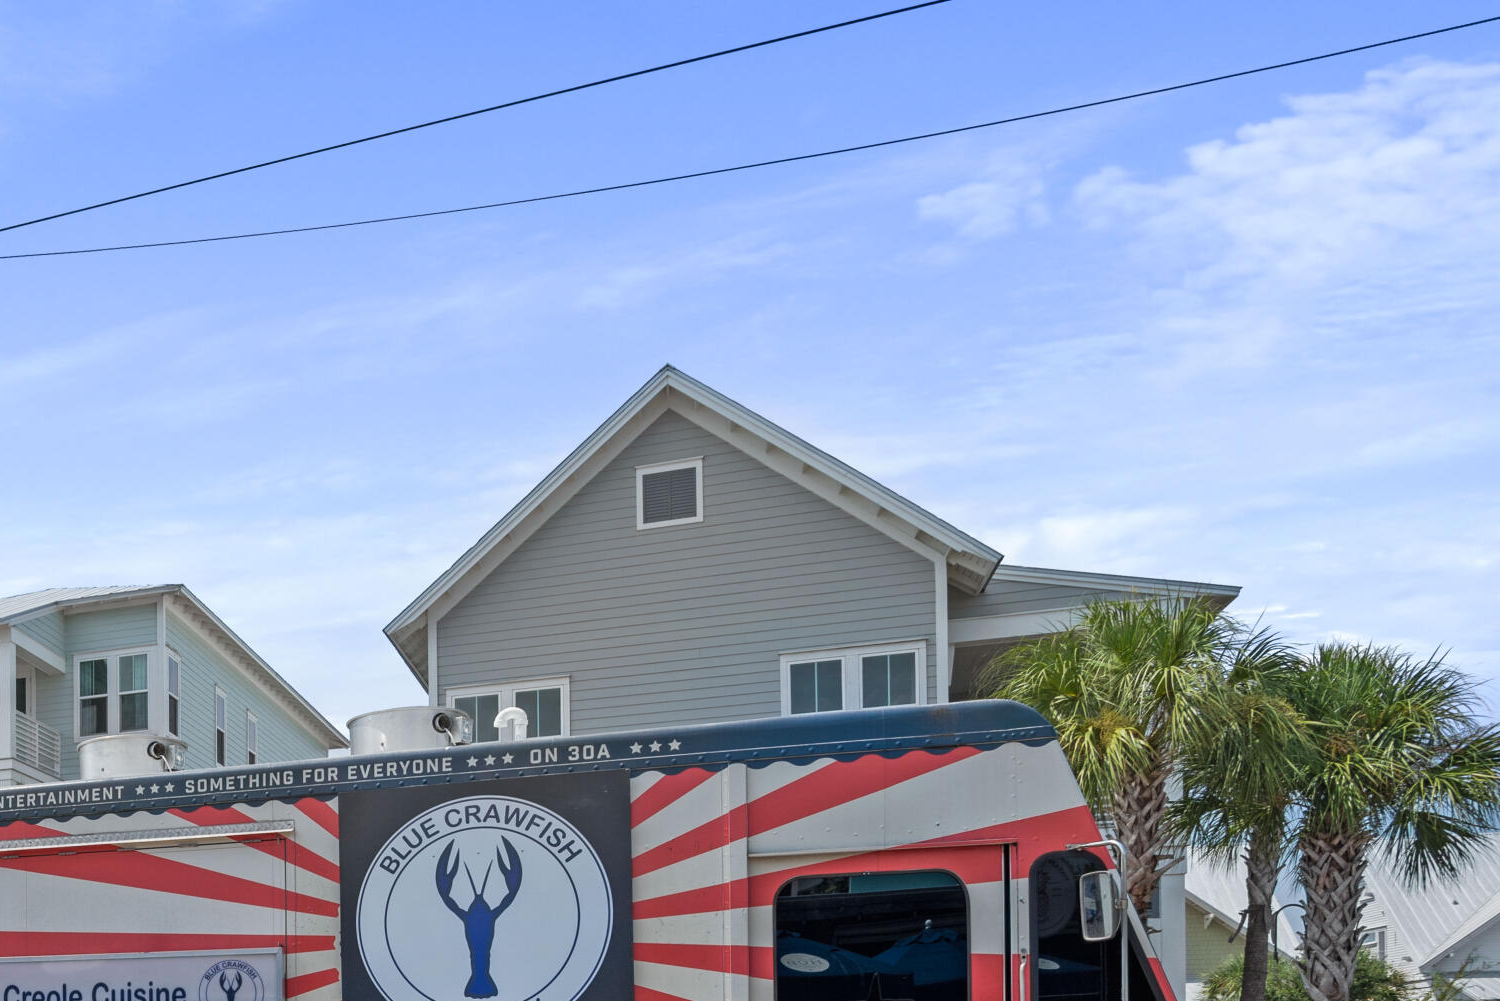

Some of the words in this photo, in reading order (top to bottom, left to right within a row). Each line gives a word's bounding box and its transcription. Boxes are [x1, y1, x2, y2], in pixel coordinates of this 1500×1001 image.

[530, 748, 558, 764] ON
[568, 744, 610, 760] 30A
[185, 771, 293, 793] SOMETHING
[303, 767, 338, 783] FOR
[348, 757, 452, 779] EVERYONE
[380, 817, 440, 875] BLUE
[444, 804, 582, 863] CRAWFISH
[205, 965, 221, 980] BLUE
[222, 961, 258, 980] CRAWFISH
